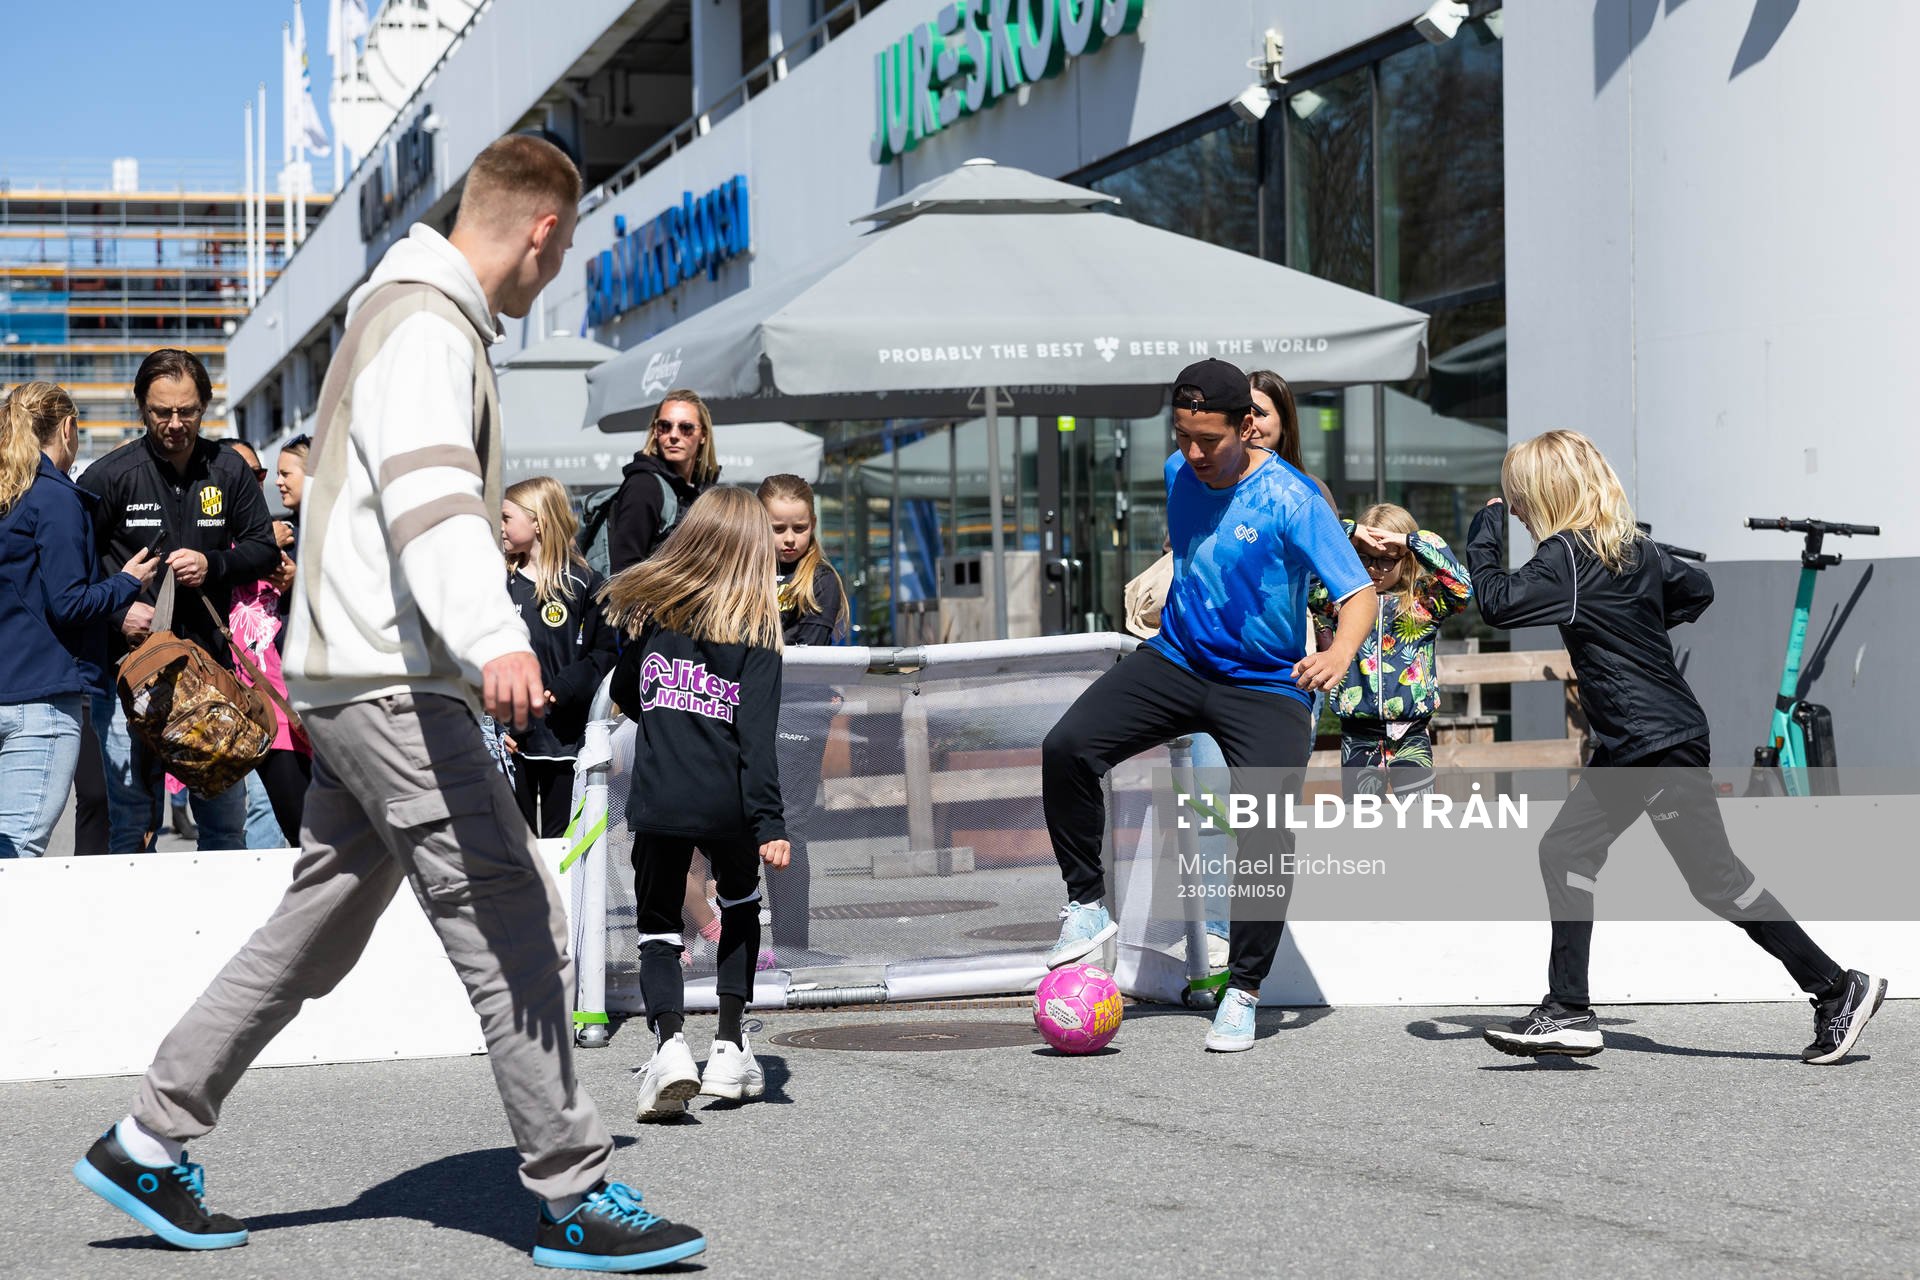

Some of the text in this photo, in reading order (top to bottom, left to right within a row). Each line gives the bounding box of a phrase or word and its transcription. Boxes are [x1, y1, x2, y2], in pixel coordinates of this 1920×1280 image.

[870, 0, 1143, 164] JURESKO
[878, 337, 1329, 364] PROBABLY THE BEST BEER IN THE WORLD
[554, 456, 587, 469] BEST
[126, 503, 154, 512] CRAFT
[659, 658, 740, 705] Jitex
[656, 687, 733, 724] Mölndal
